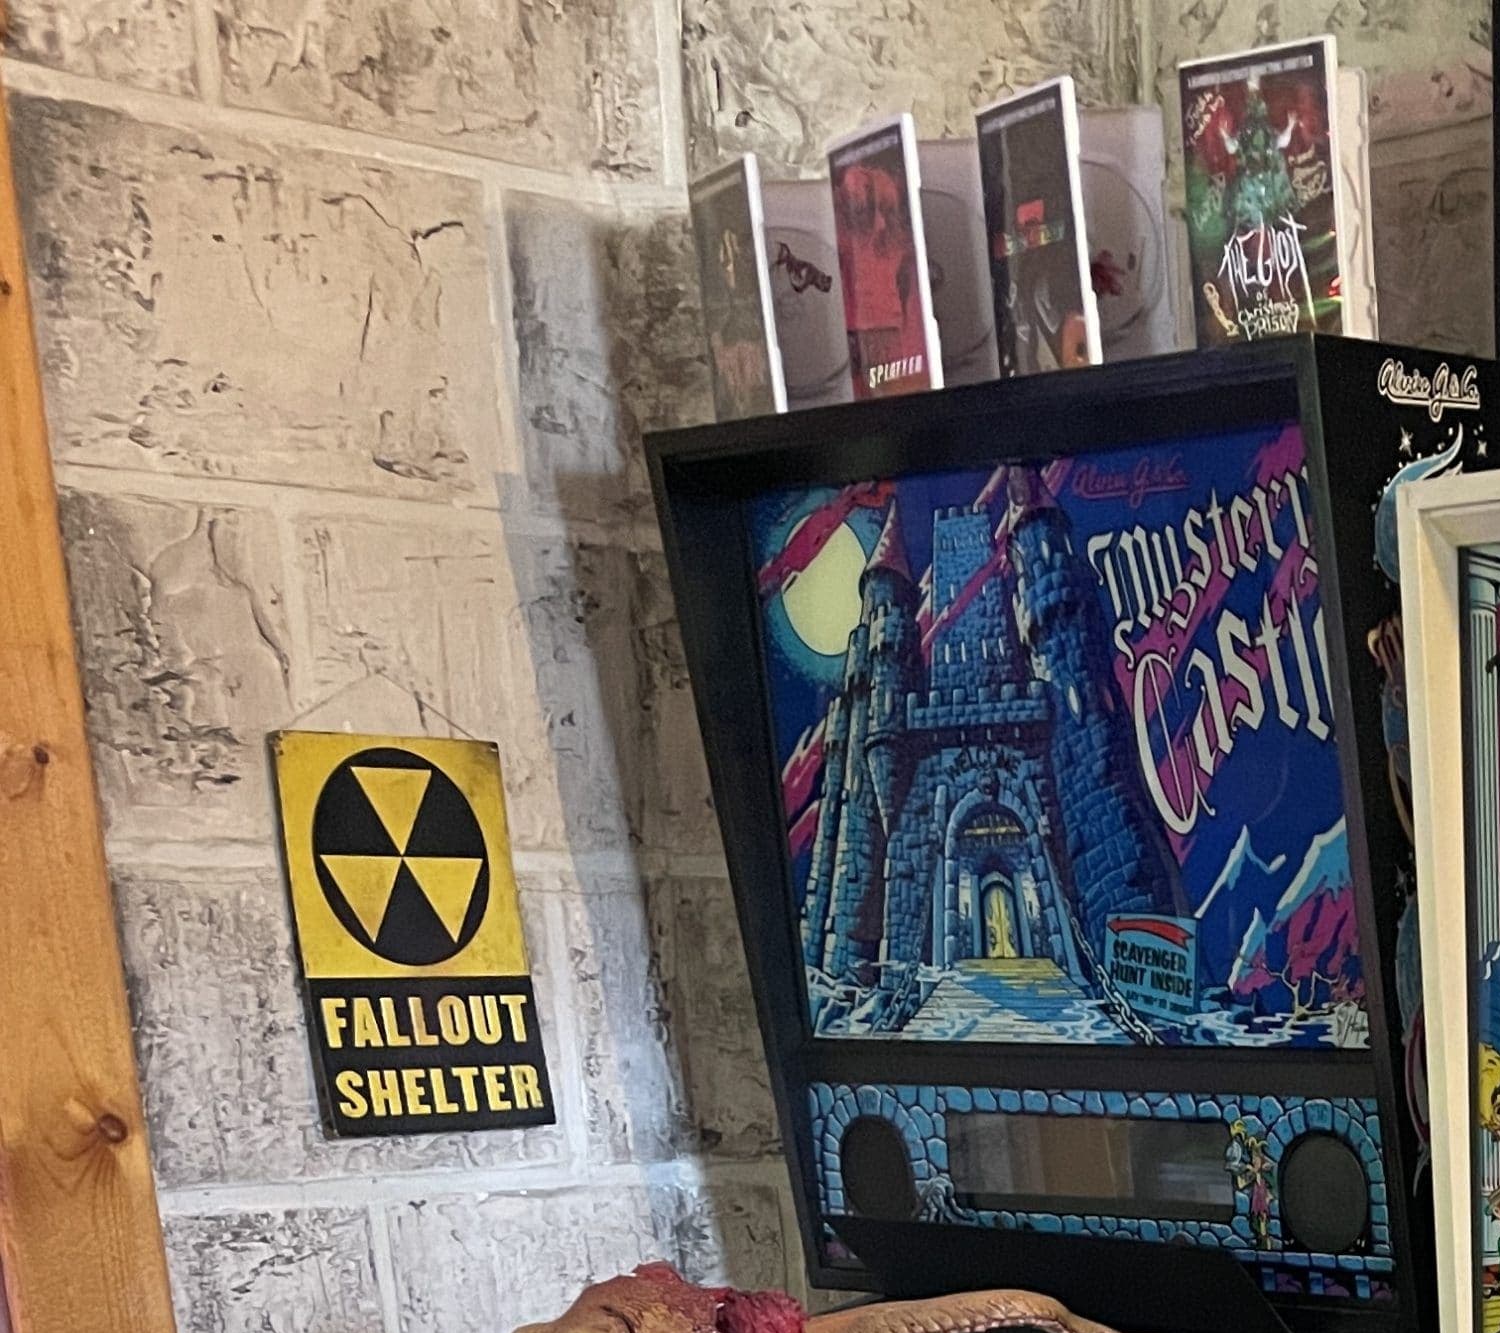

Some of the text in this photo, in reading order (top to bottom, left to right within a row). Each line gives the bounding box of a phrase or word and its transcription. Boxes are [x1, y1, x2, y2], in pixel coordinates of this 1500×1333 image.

[1110, 959, 1193, 998] HUNT INSIDE
[1112, 939, 1187, 974] SCAVENGER
[320, 994, 528, 1049] FALLOUT
[335, 1065, 545, 1118] SHELTER
